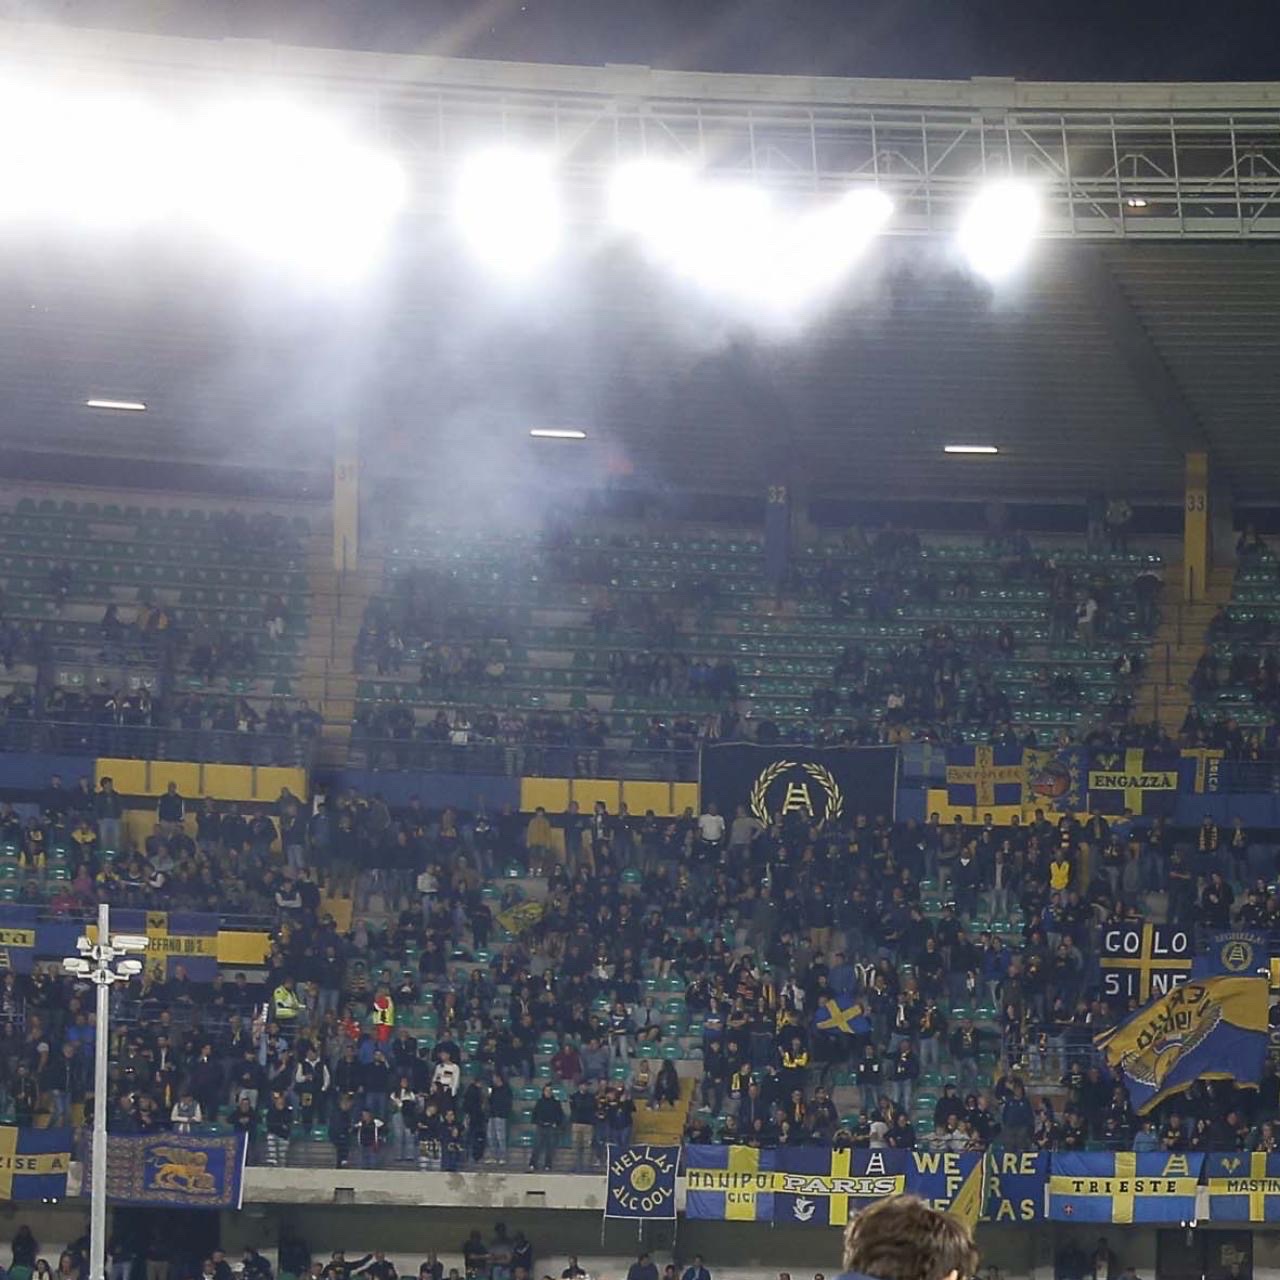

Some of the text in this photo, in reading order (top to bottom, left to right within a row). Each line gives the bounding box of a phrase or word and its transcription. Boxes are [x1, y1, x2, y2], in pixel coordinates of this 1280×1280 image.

[1187, 495, 1204, 512] 33
[911, 1151, 962, 1175] WE
[783, 1174, 897, 1194] PARIS
[1072, 1180, 1178, 1194] TRIESTE
